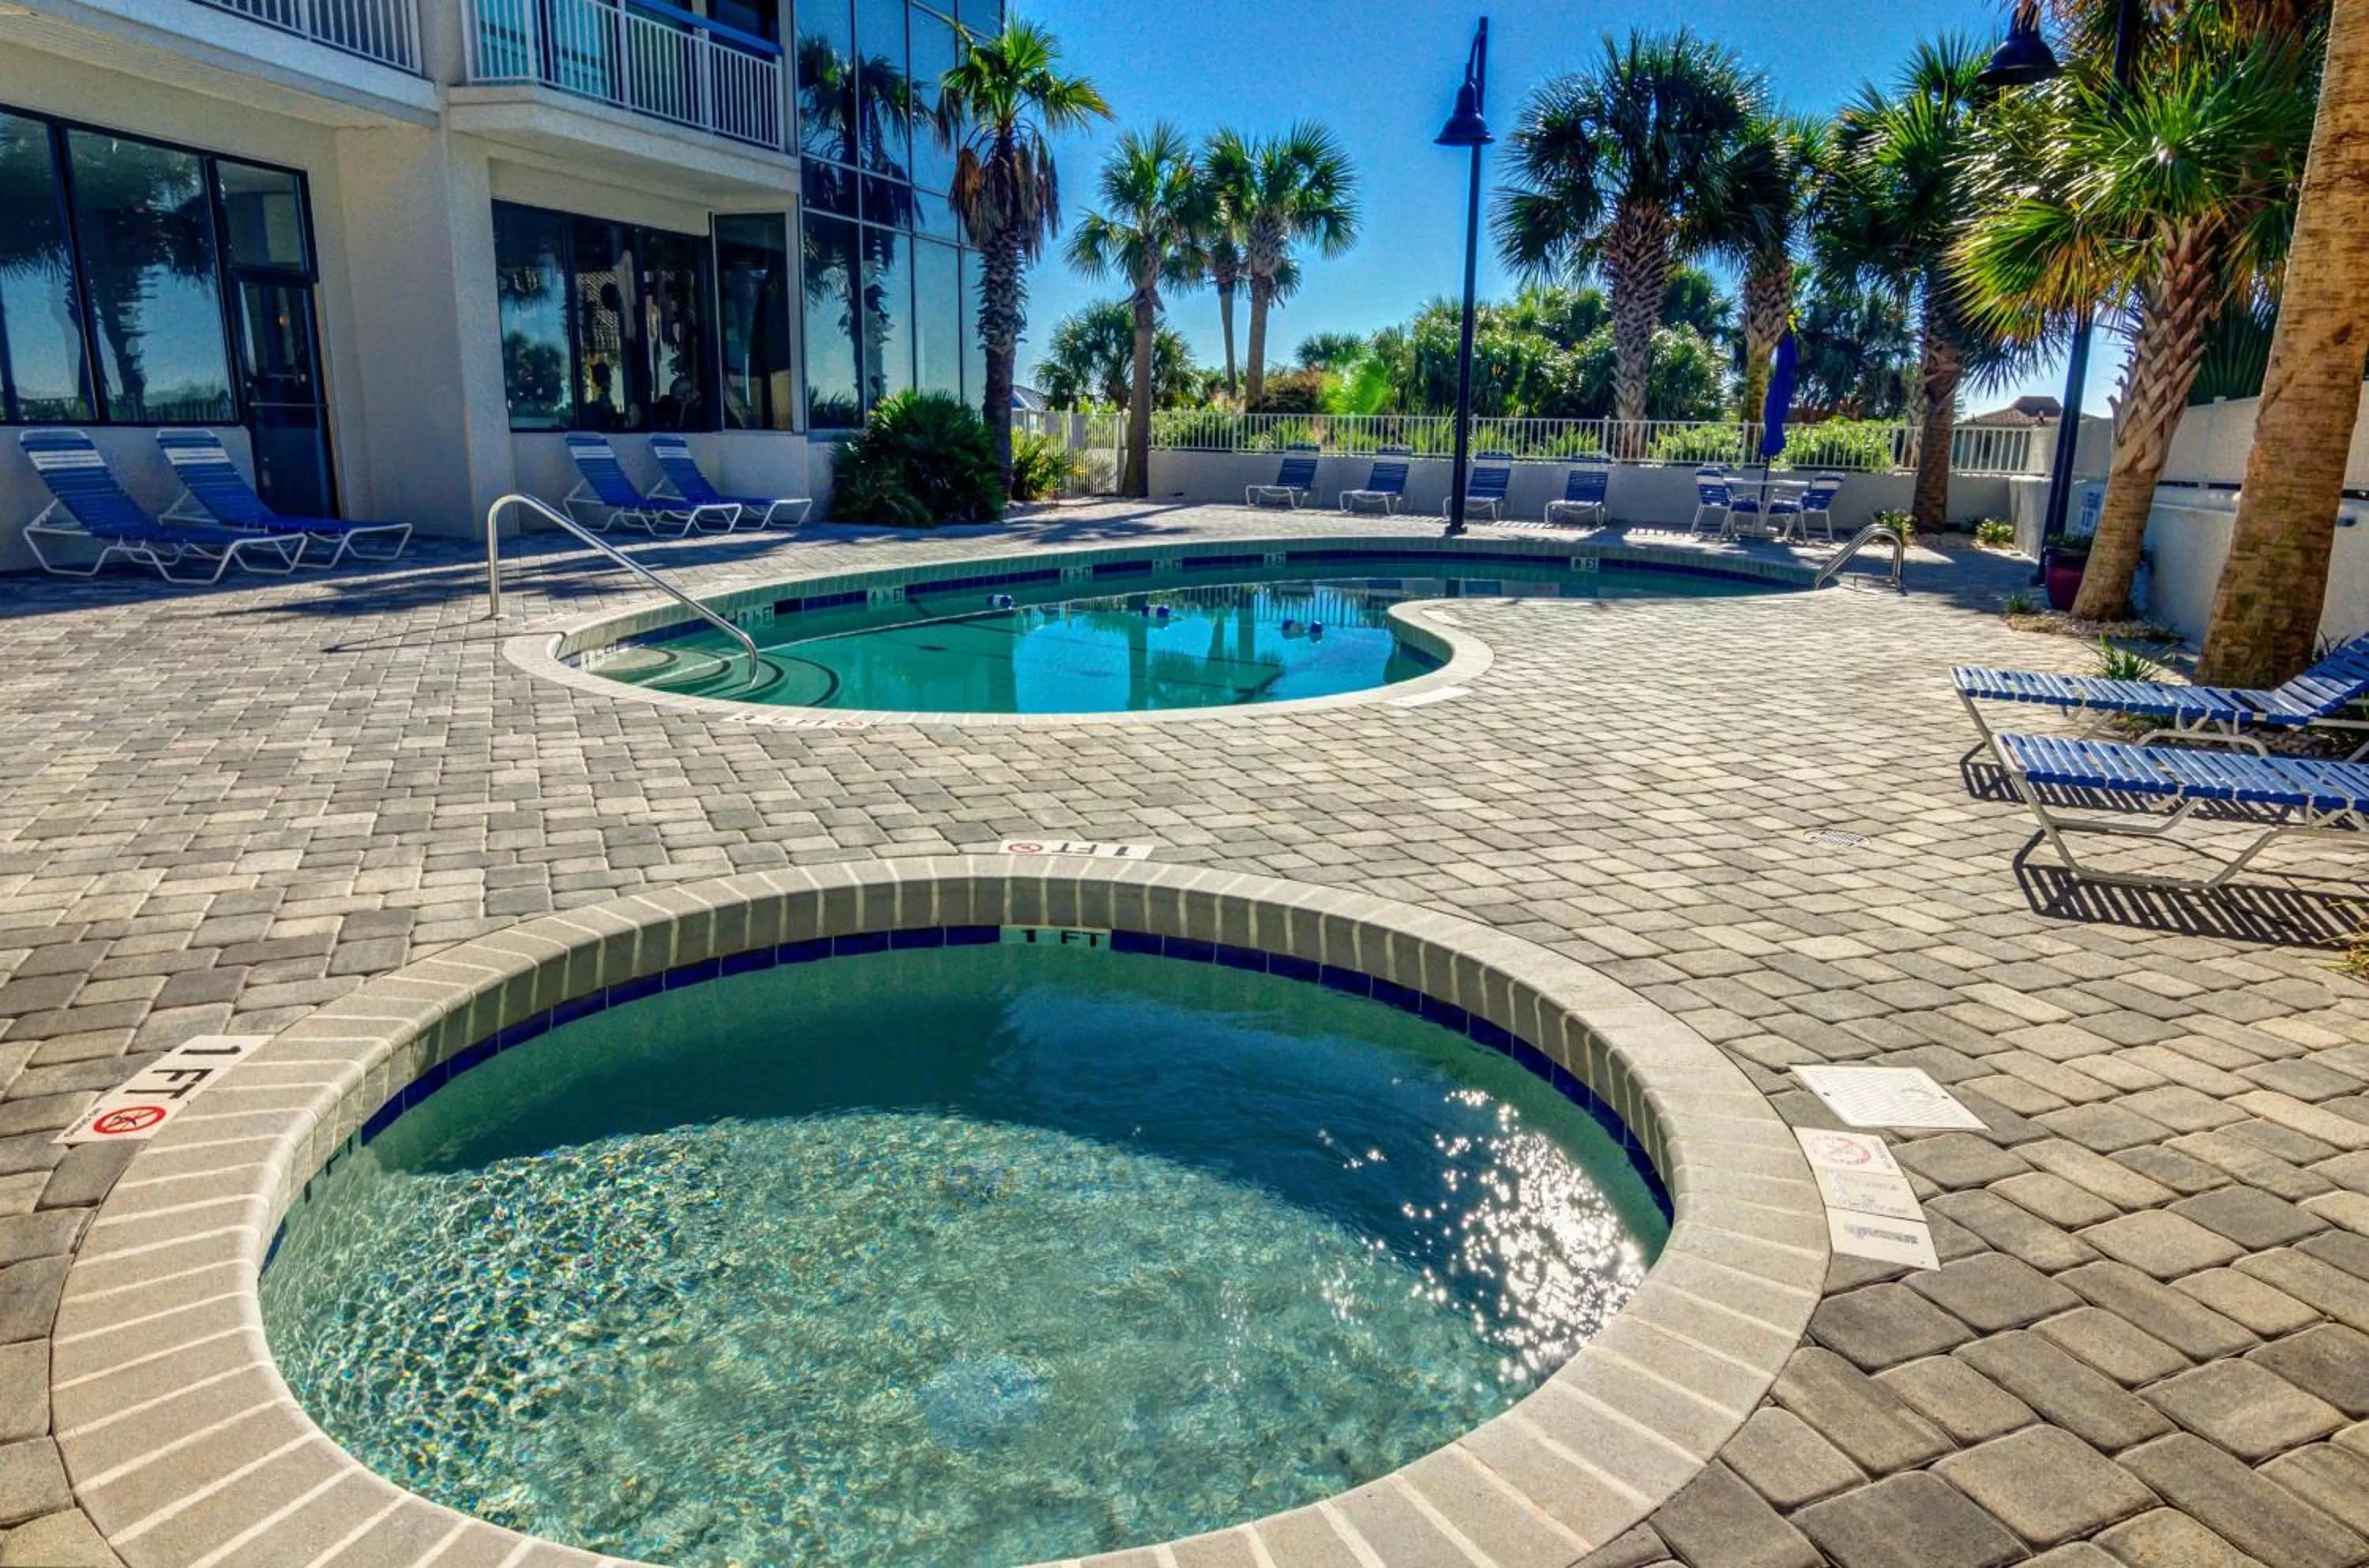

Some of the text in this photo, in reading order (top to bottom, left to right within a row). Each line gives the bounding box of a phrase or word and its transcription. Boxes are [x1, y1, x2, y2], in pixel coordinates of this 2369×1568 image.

[1051, 842, 1129, 857] 1 FT
[1022, 928, 1107, 947] 1 FT
[123, 1045, 242, 1100] 1 FT
